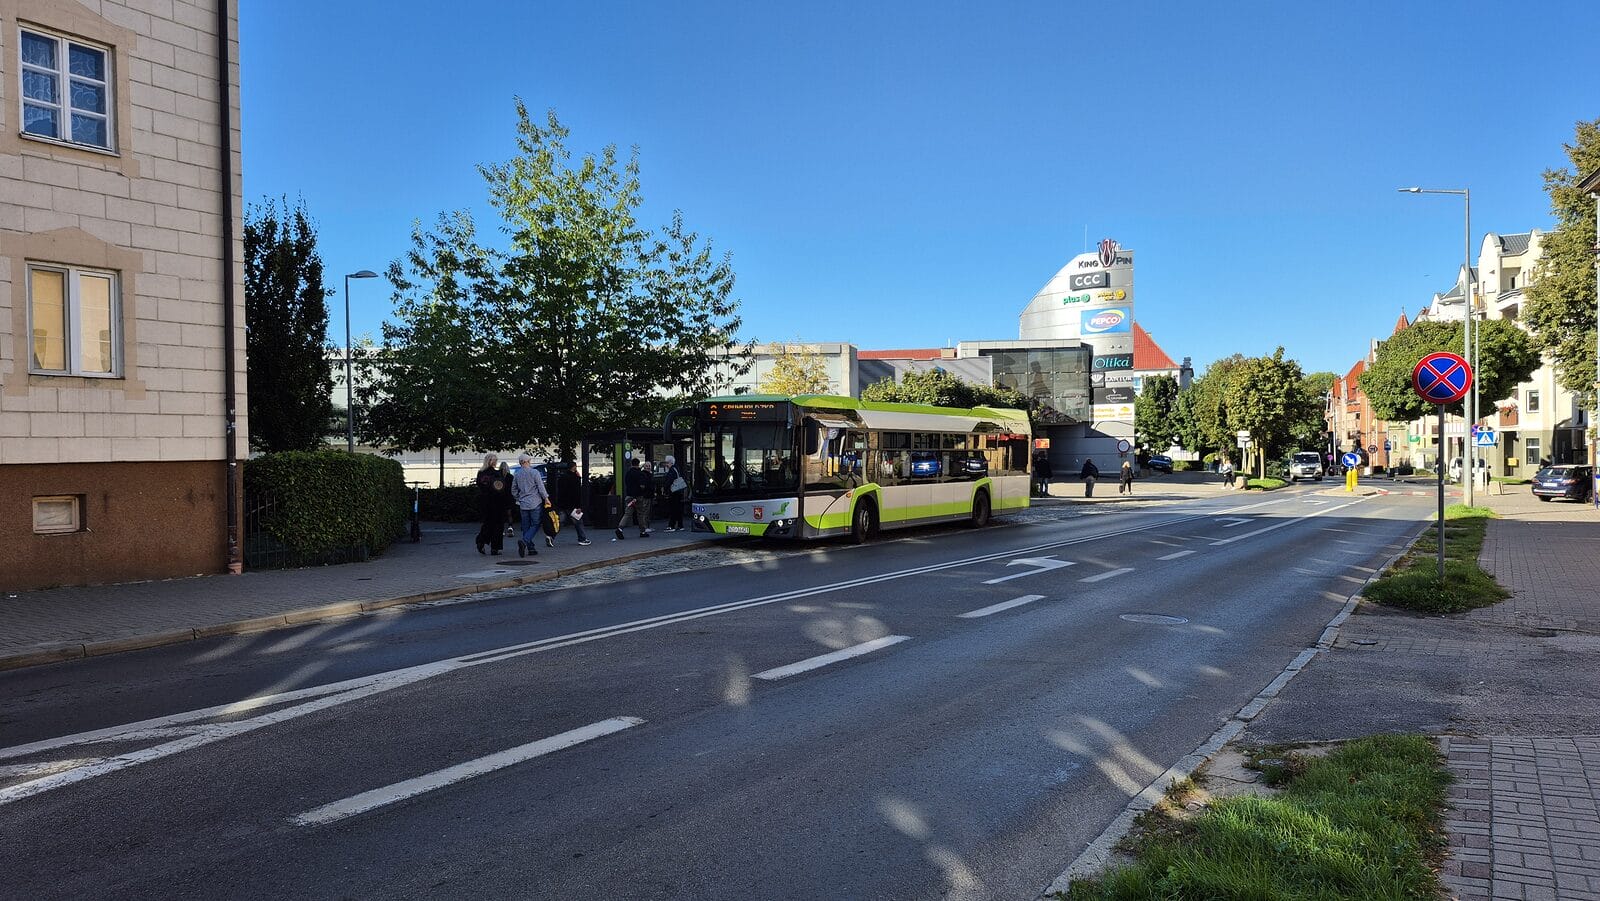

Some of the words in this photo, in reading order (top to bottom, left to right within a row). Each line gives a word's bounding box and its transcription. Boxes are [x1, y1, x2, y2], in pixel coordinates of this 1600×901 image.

[1078, 260, 1099, 269] KING
[1116, 256, 1132, 265] PIN
[1074, 274, 1101, 287] CCC
[1063, 296, 1081, 305] plus
[1090, 315, 1121, 326] PEPCO
[1094, 357, 1130, 368] Olika
